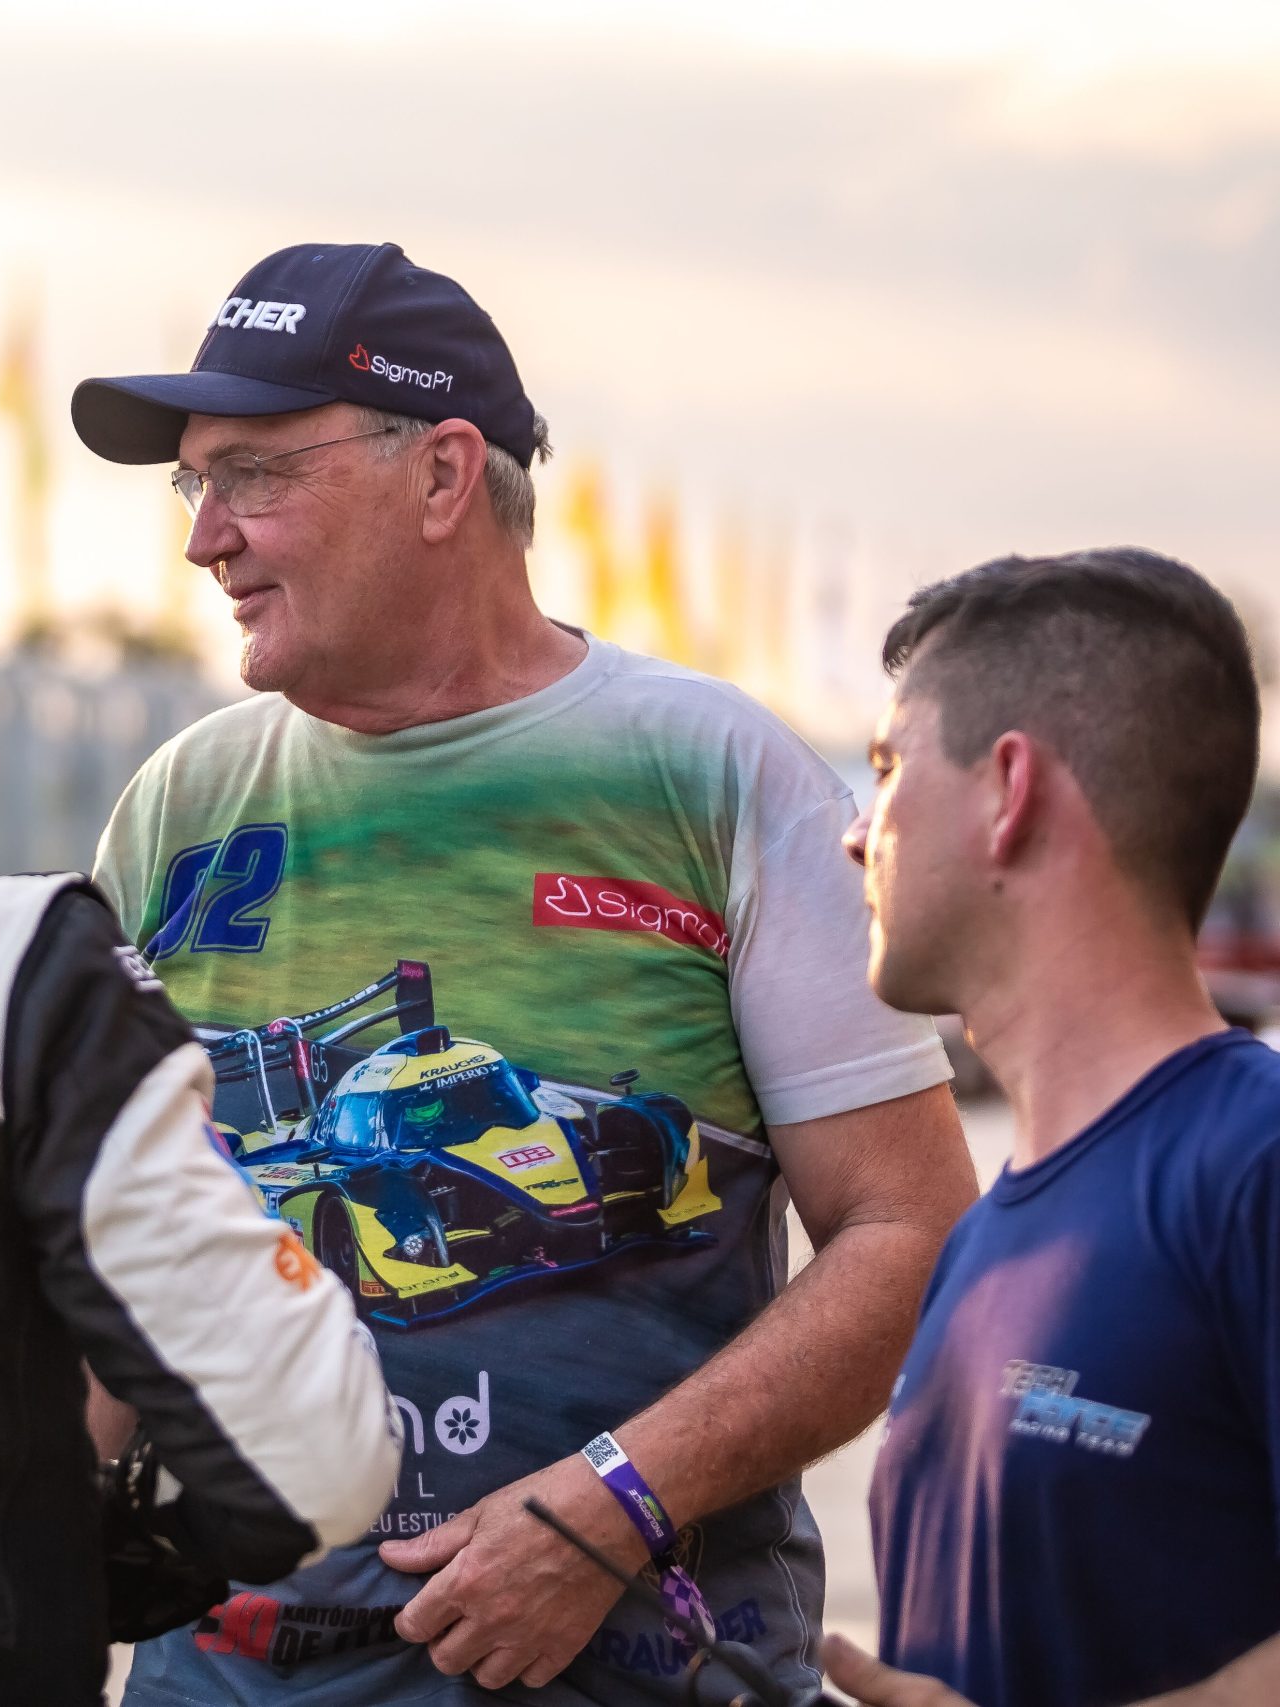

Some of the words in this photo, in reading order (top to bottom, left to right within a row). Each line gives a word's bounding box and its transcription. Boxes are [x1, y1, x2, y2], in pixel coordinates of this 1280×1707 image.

[208, 297, 306, 334] CHER
[370, 355, 453, 393] SigmaP1
[370, 1514, 393, 1533] EU
